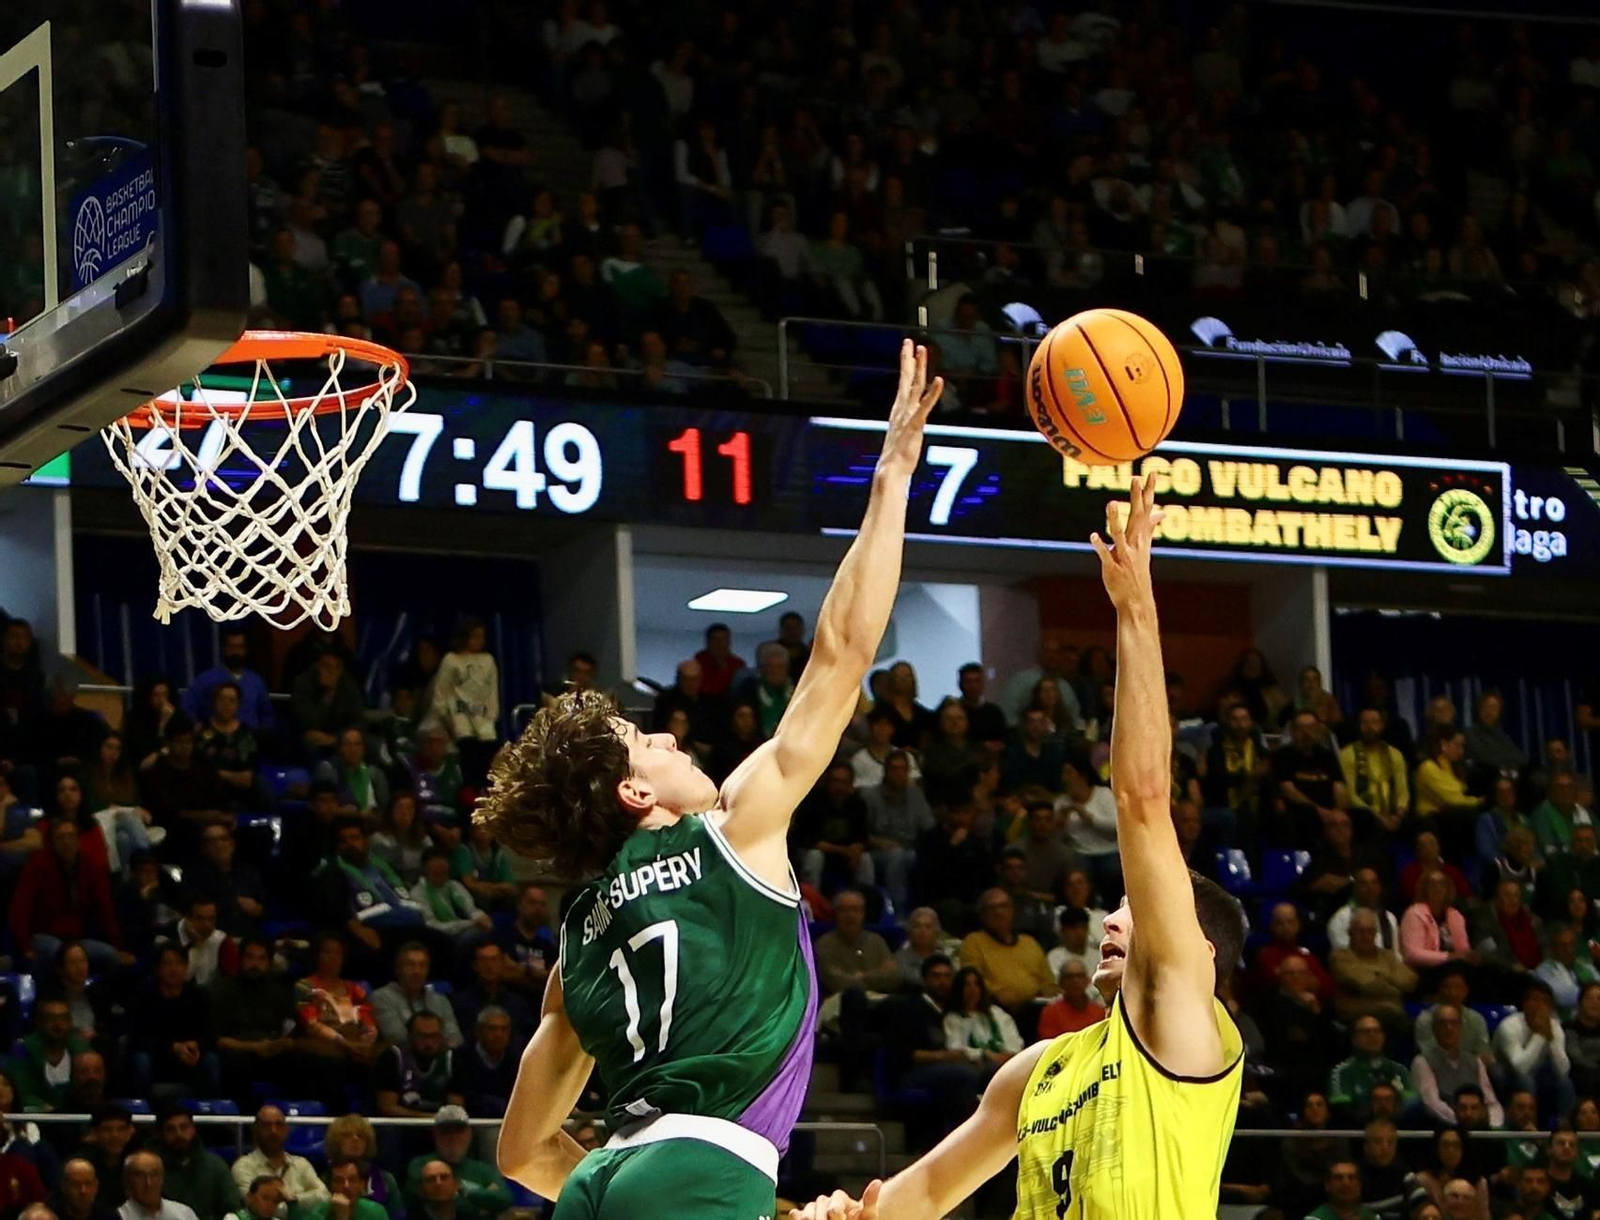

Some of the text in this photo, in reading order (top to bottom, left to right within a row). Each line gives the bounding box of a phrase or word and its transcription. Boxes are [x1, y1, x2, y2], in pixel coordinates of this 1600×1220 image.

[106, 165, 154, 213] BASKETBAL
[106, 189, 156, 238] CHAMPIO
[107, 223, 141, 260] LEAGUE
[384, 411, 602, 514] 7:49
[667, 427, 751, 505] 11
[1208, 459, 1403, 509] VULCANO
[1106, 501, 1403, 554] SOMBATHELY
[609, 919, 678, 1063] 17
[1052, 1149, 1074, 1220] 9
